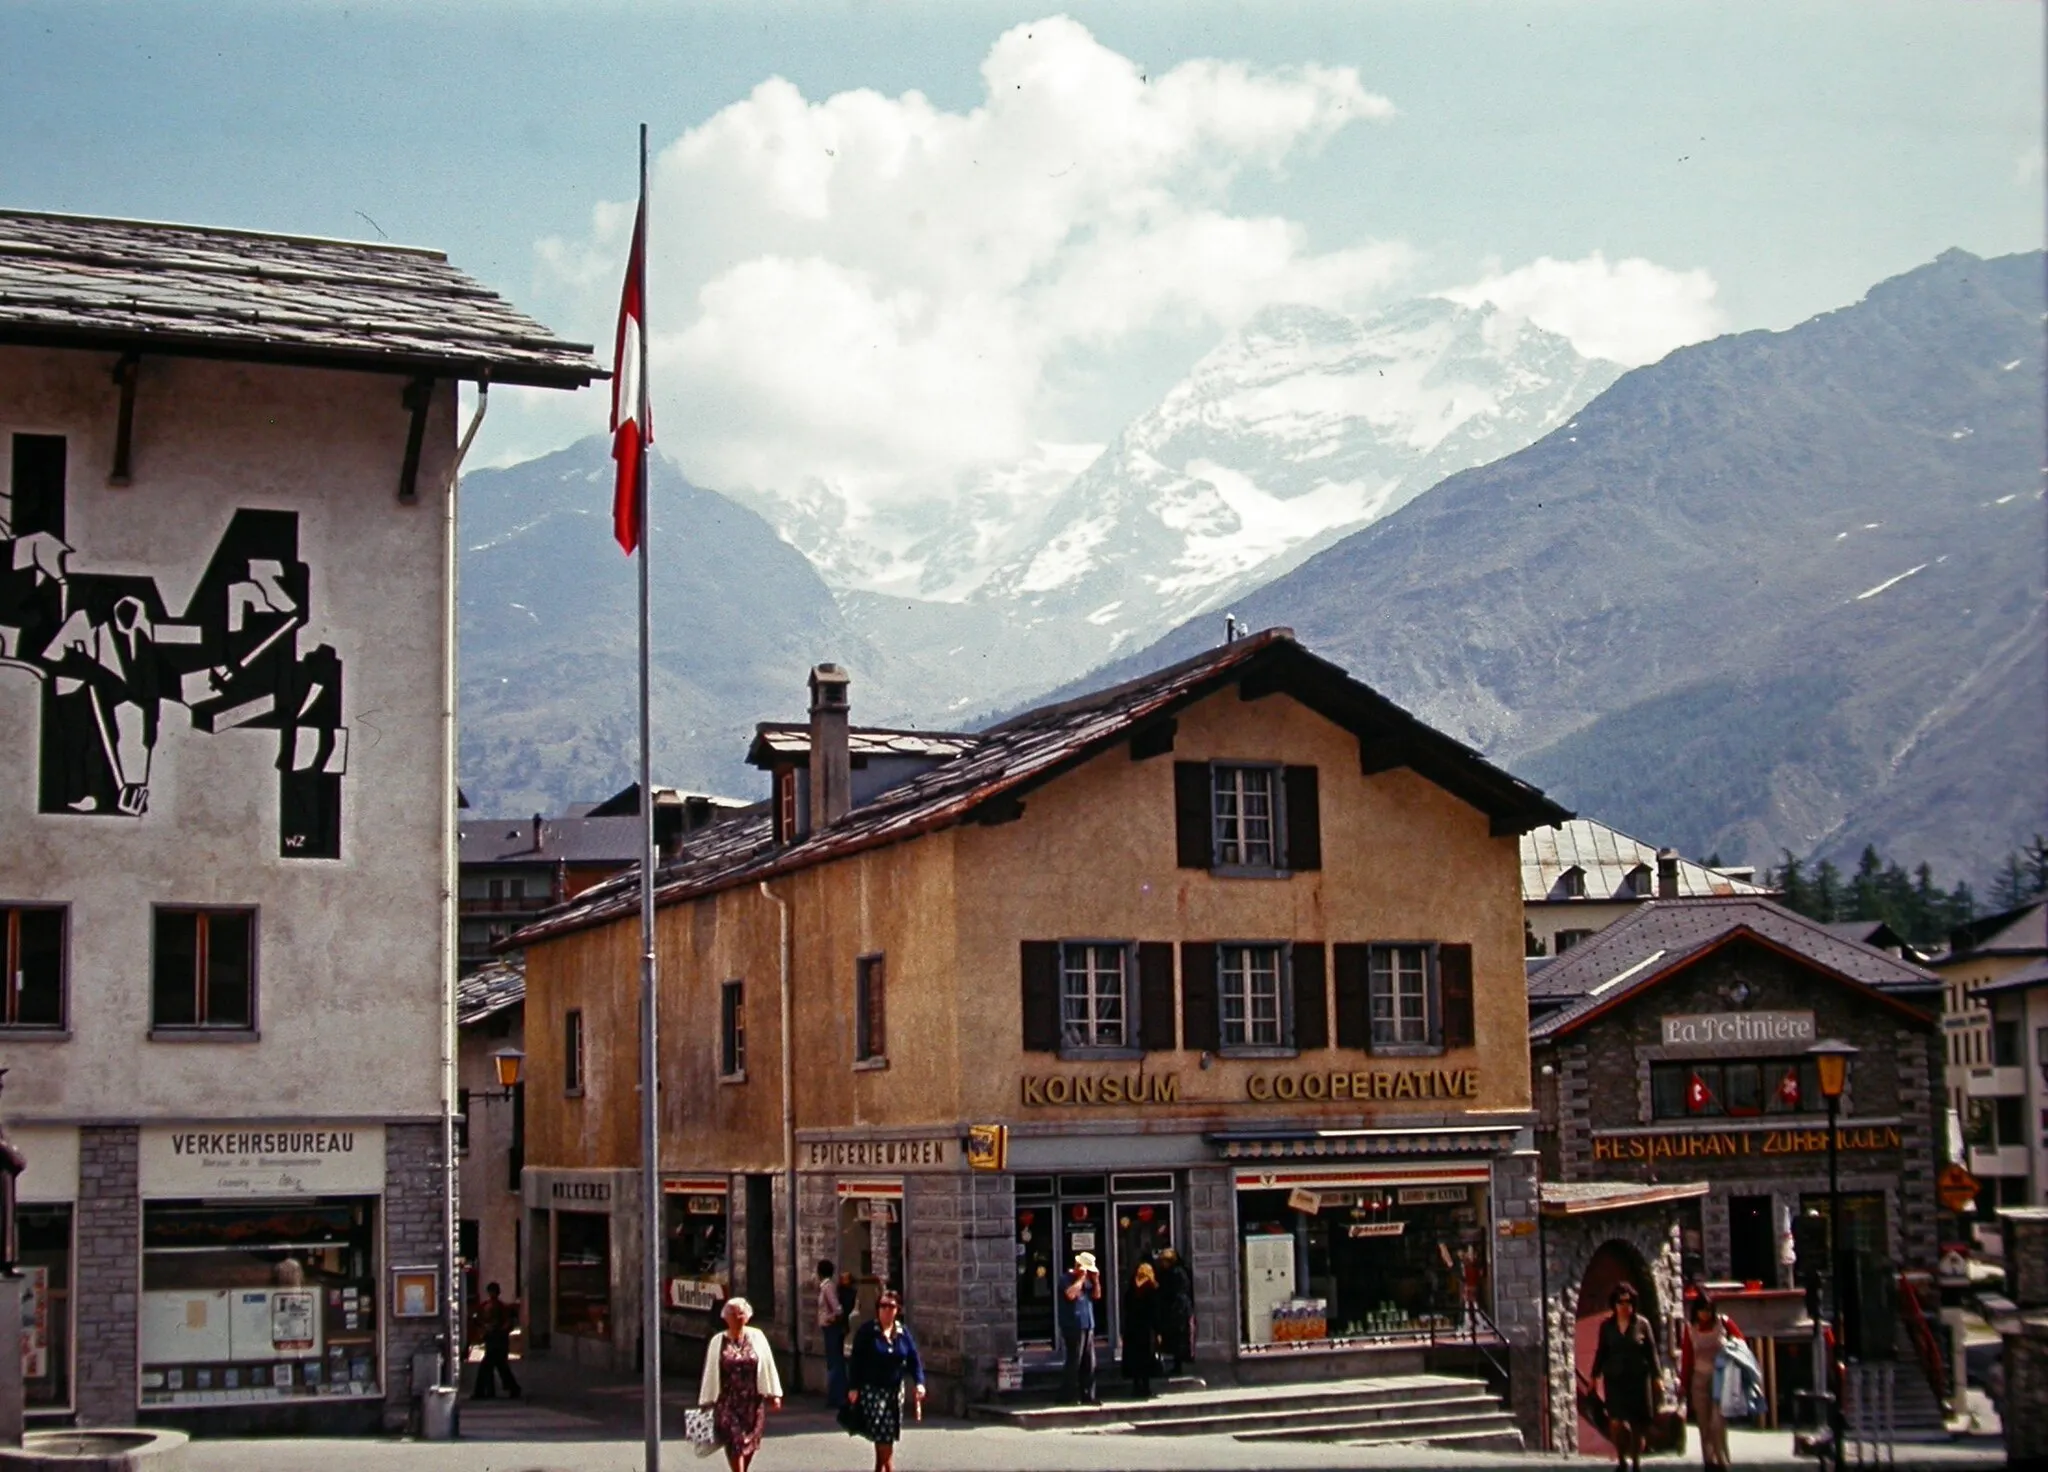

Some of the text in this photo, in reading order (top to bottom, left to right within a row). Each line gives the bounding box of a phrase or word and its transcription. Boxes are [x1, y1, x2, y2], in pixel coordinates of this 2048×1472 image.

[1667, 1020, 1697, 1042] La
[1021, 1069, 1481, 1105] KONSUM COOPERATIVE
[172, 1132, 353, 1155] VERKEHRSBUREAU
[1593, 1132, 1750, 1161] RESTAURANT
